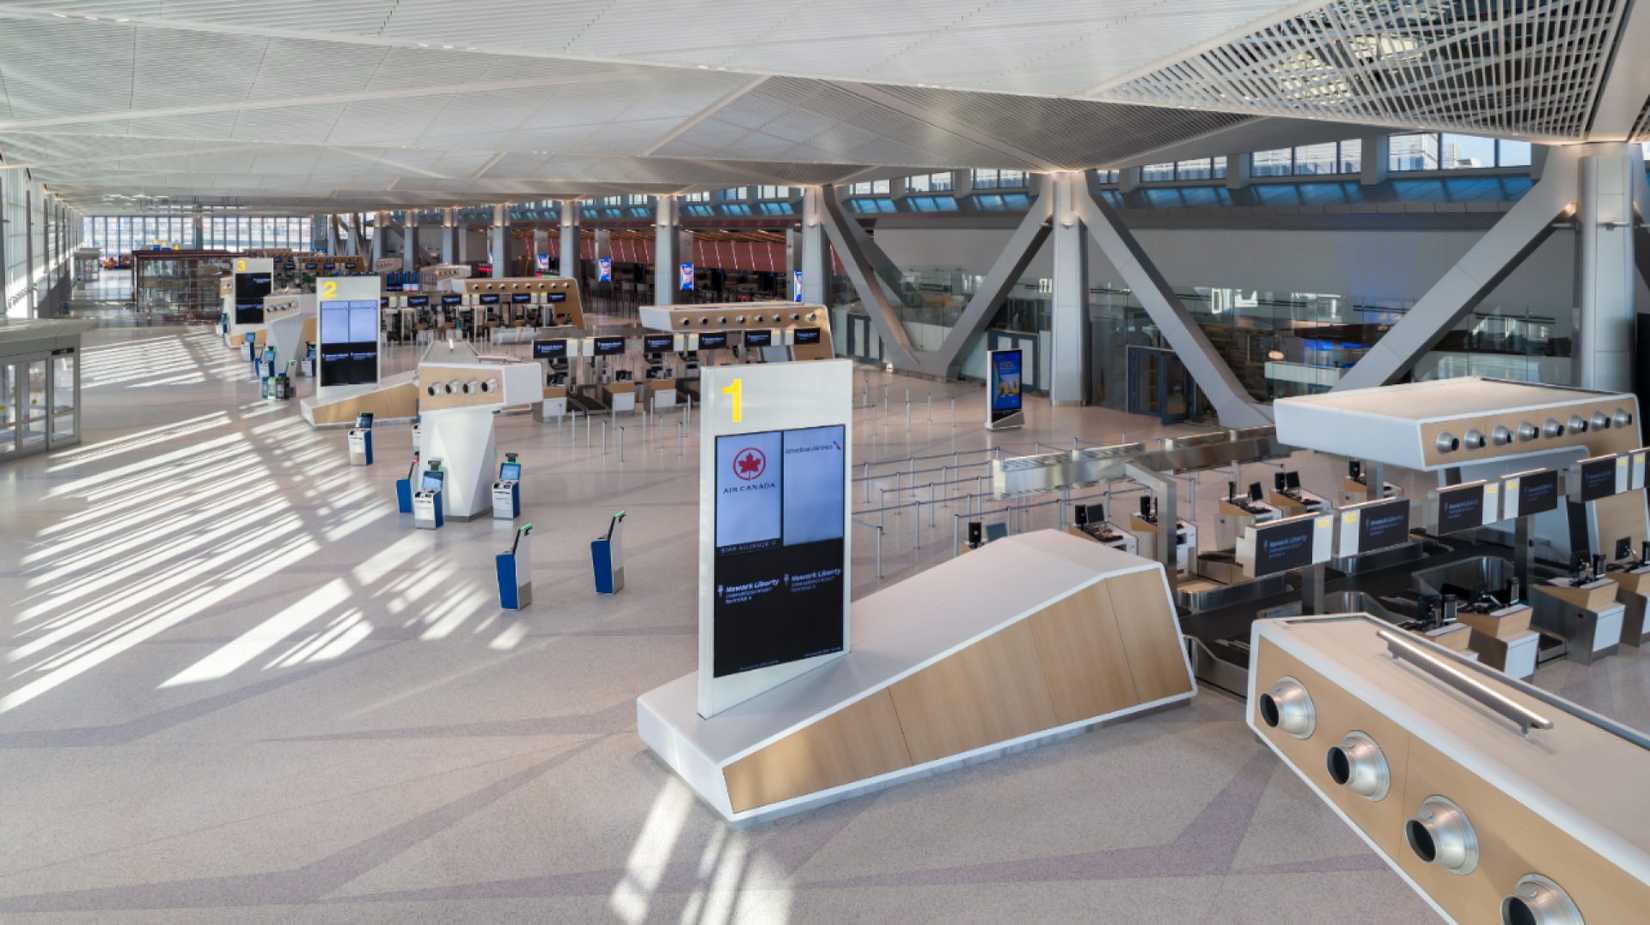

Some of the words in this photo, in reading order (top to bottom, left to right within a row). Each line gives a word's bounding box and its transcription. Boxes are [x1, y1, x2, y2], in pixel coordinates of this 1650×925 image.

[321, 280, 337, 299] 2
[722, 378, 742, 423] 1
[722, 487, 738, 496] AIR
[739, 481, 776, 492] CANADA
[817, 568, 841, 578] Liberty
[754, 578, 779, 589] Liberty
